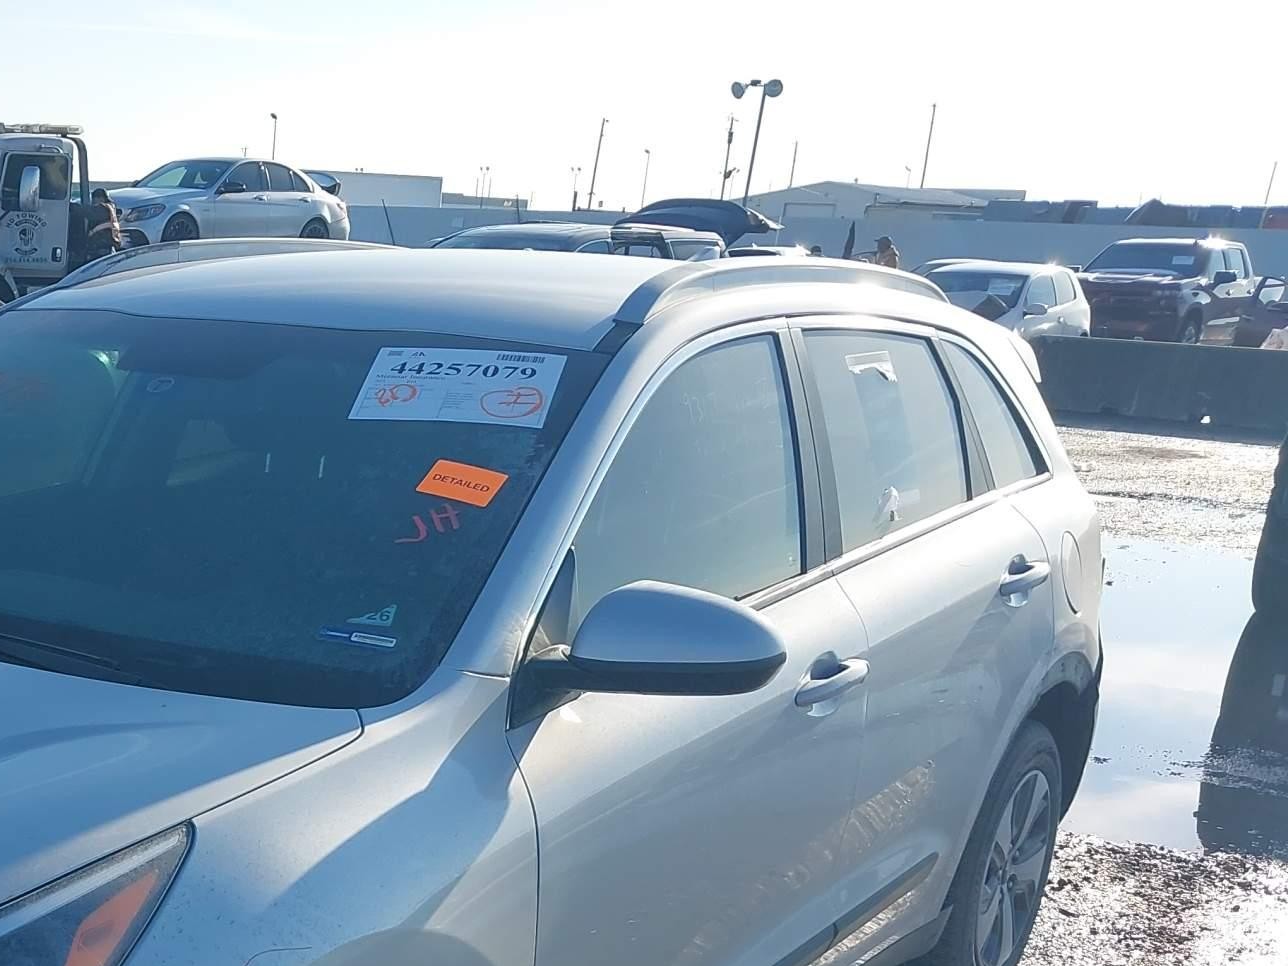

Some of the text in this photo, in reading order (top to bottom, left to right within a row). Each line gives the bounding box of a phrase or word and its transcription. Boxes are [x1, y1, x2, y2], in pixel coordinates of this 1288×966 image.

[16, 213, 48, 227] TOWING
[390, 361, 537, 379] 44257079
[432, 473, 490, 493] DETAILED
